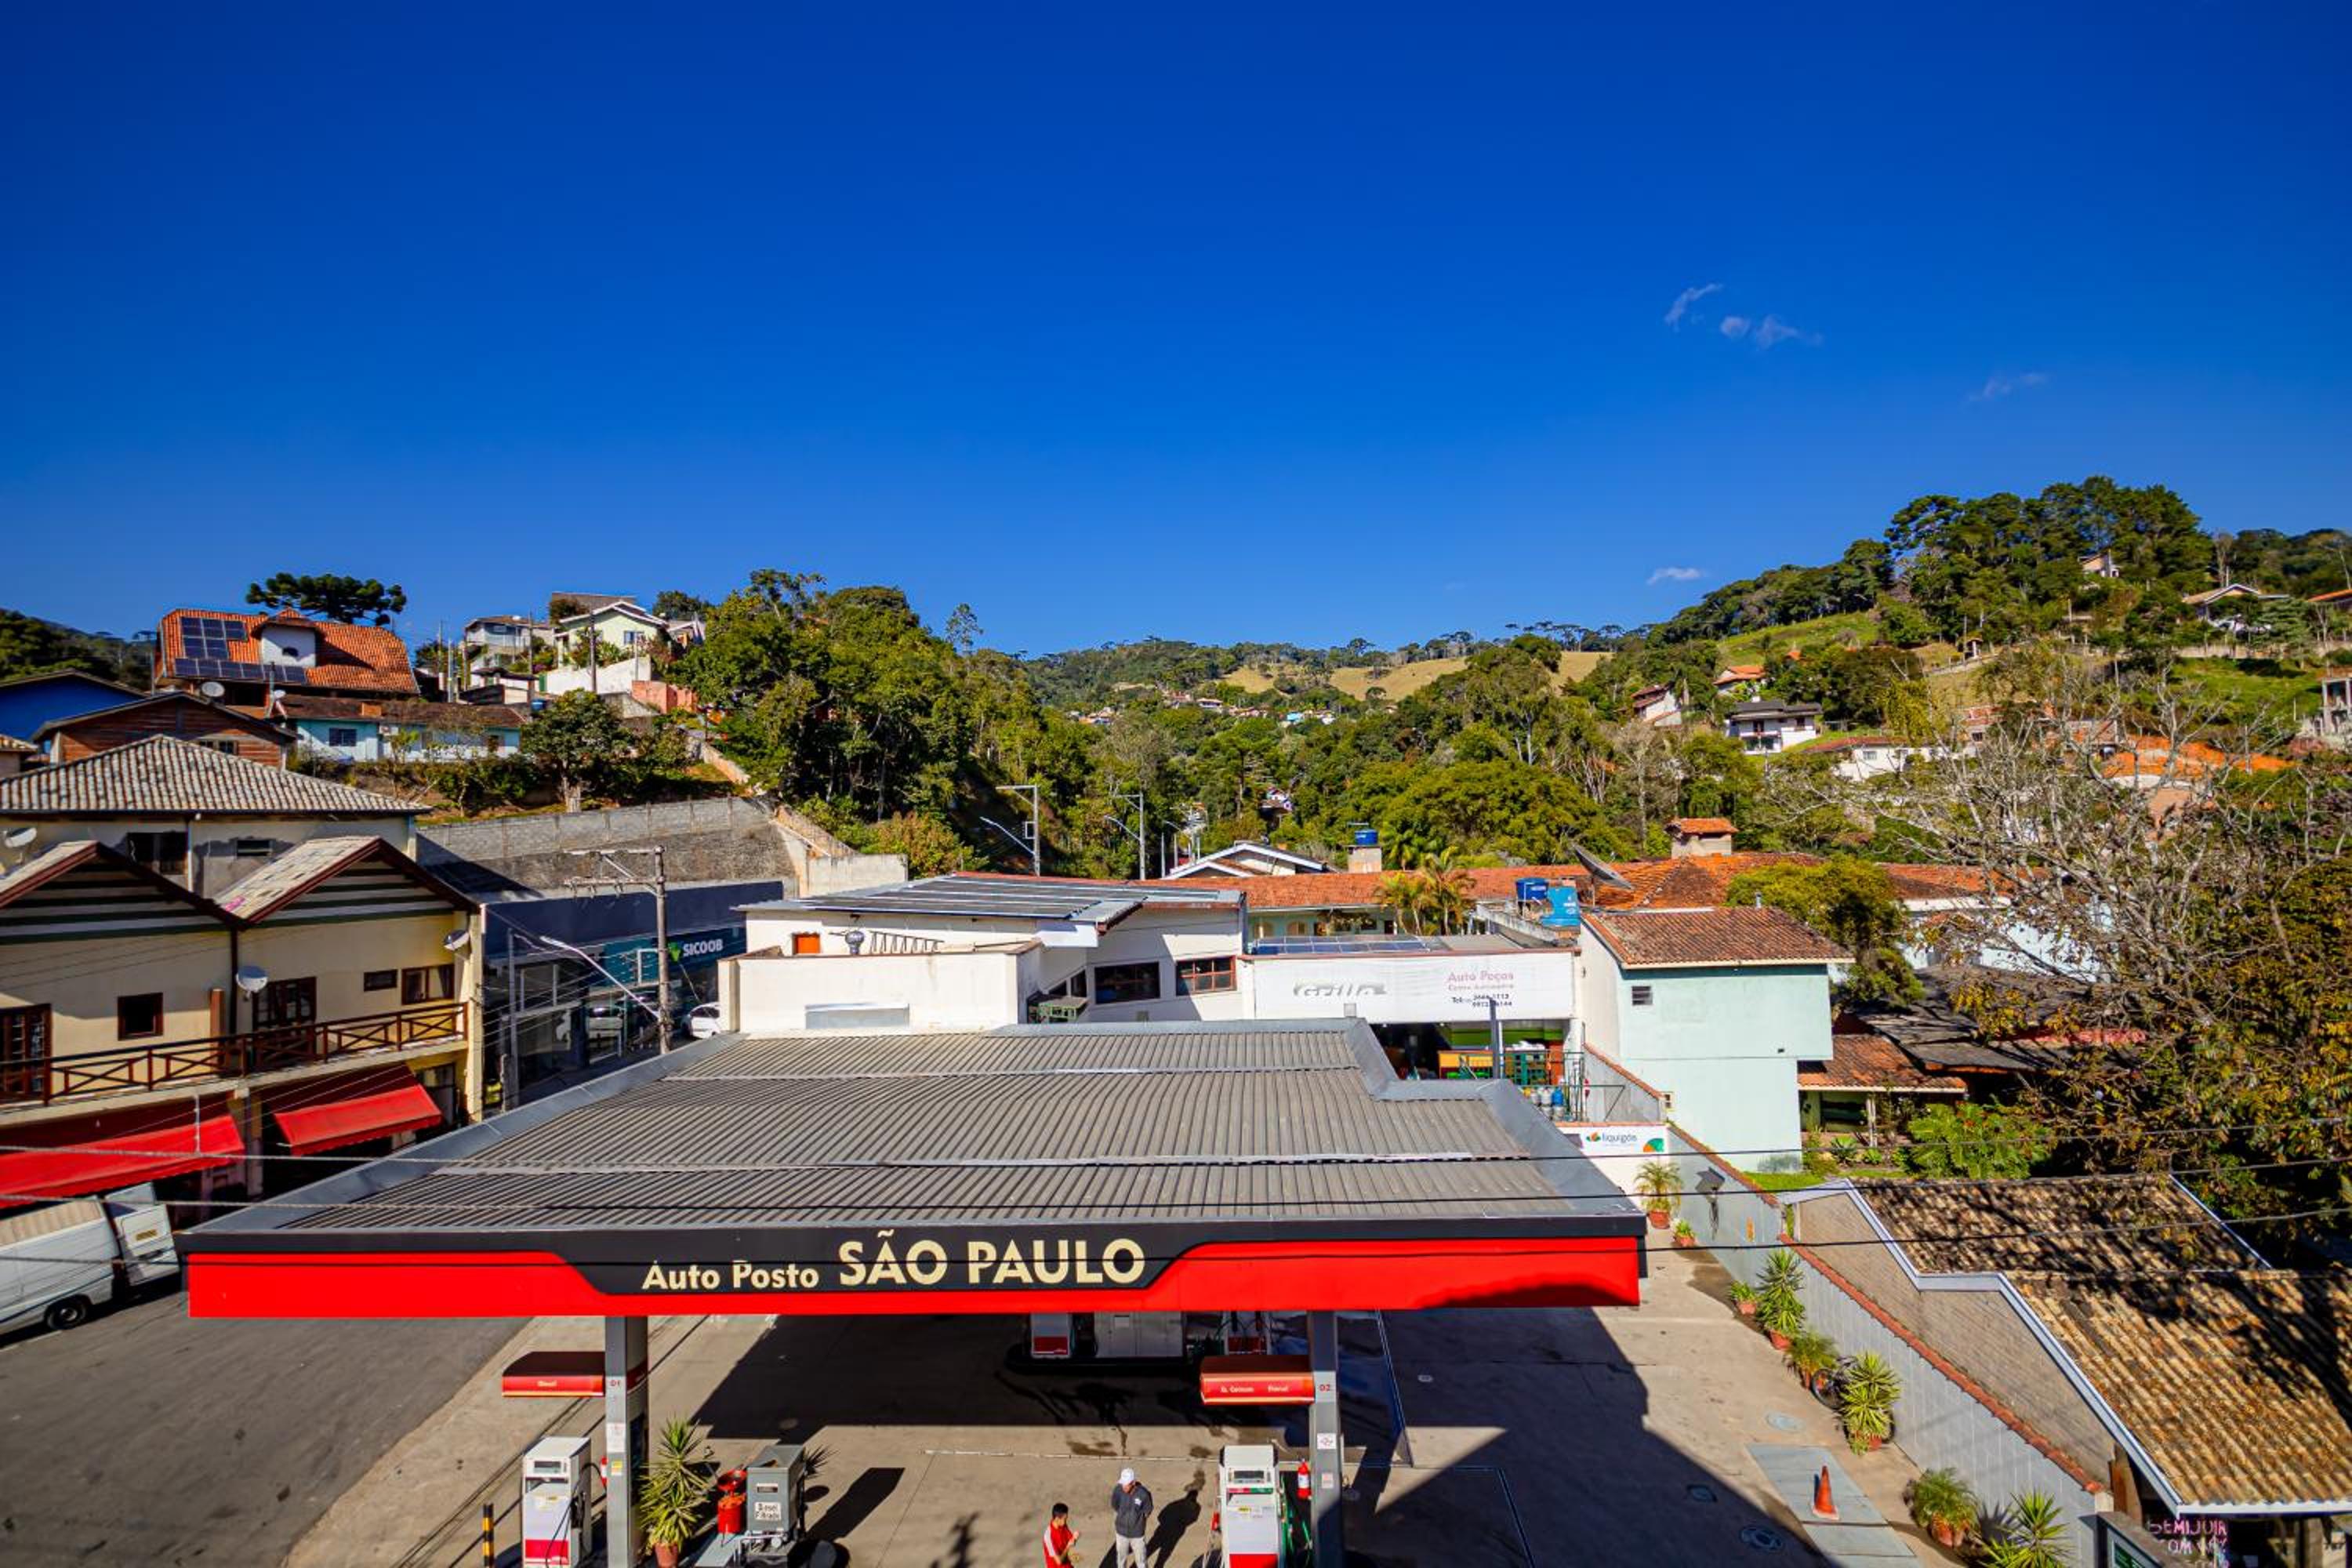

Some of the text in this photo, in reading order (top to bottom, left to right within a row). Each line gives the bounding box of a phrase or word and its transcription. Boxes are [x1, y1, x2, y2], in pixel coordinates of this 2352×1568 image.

[683, 938, 723, 956] SICOOB
[642, 1229, 1145, 1290] Auto Posto SÃO PAULO
